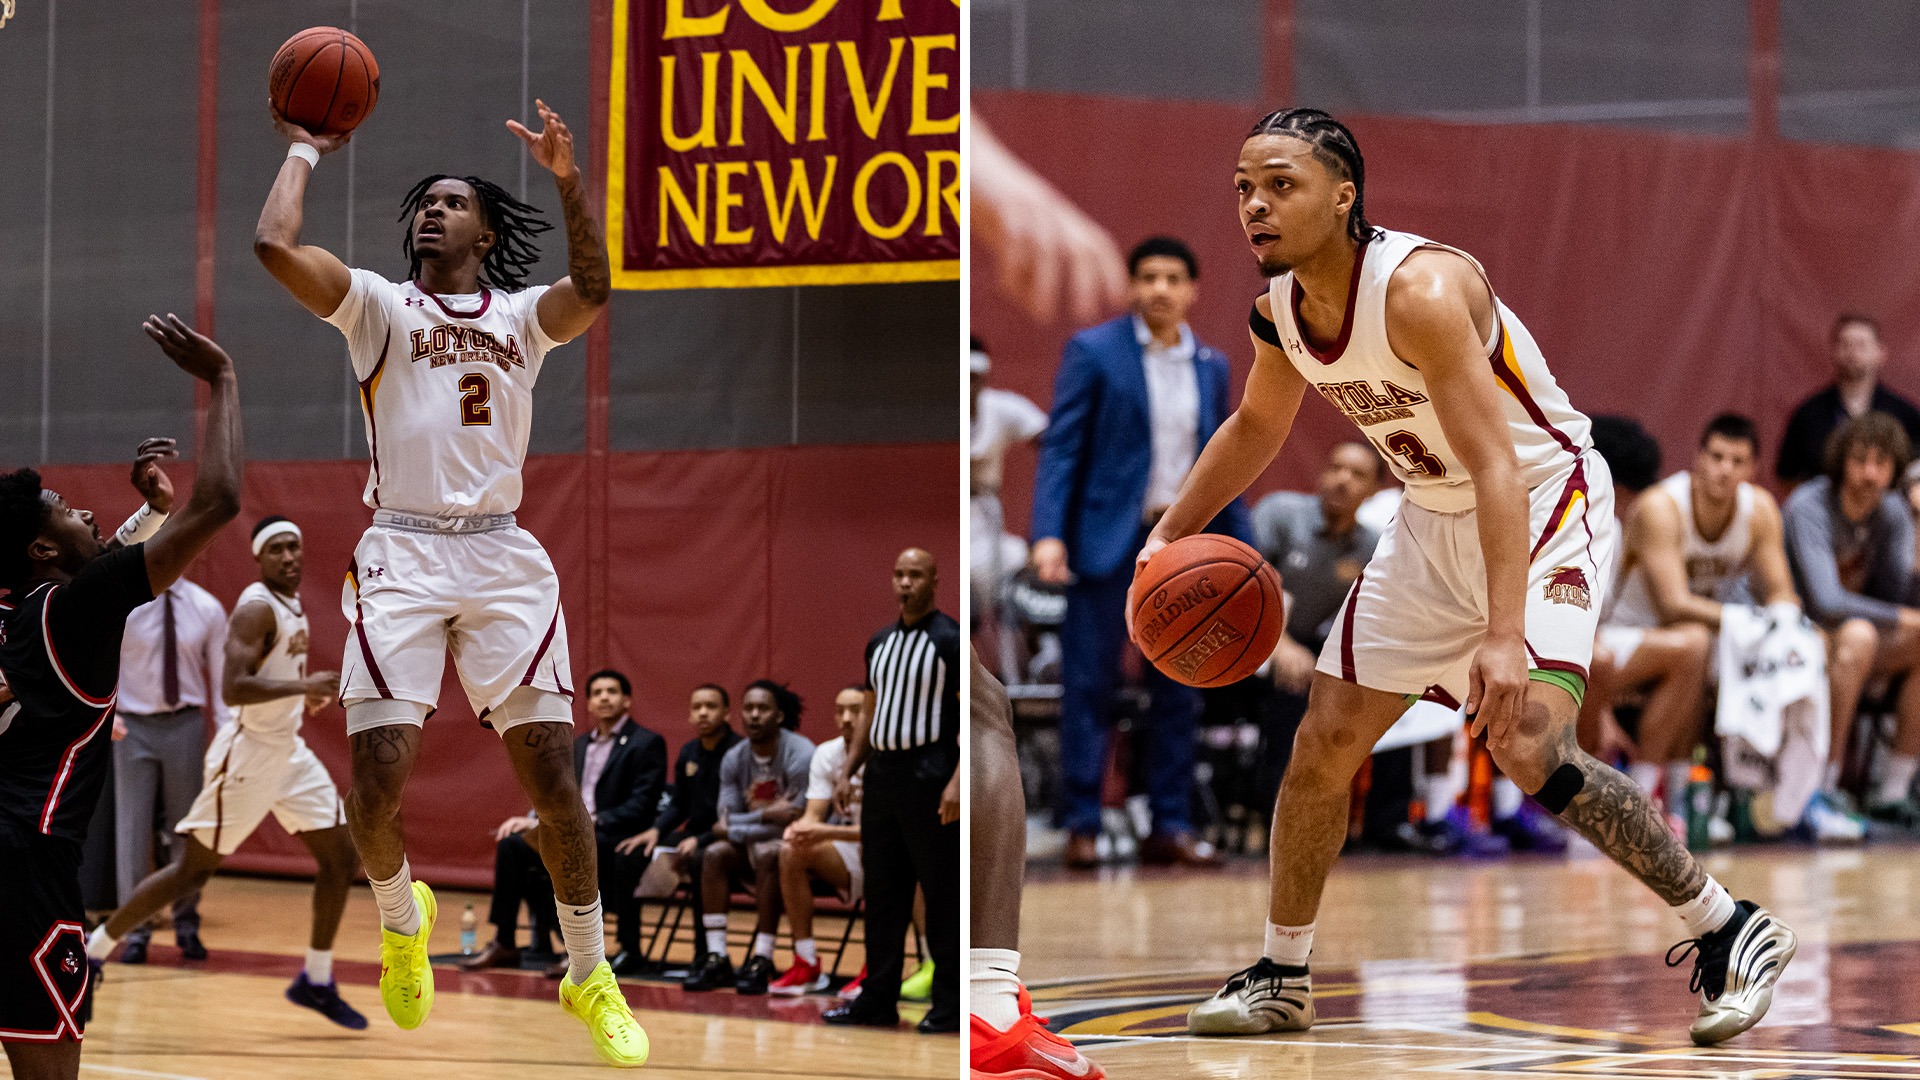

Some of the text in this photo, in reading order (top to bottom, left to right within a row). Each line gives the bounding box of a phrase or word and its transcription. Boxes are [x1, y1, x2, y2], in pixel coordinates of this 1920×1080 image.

[659, 34, 960, 152] UNIVE
[657, 150, 960, 247] NEW OR
[410, 323, 525, 370] LOYOLA
[429, 353, 457, 369] NEW
[458, 373, 492, 427] 2
